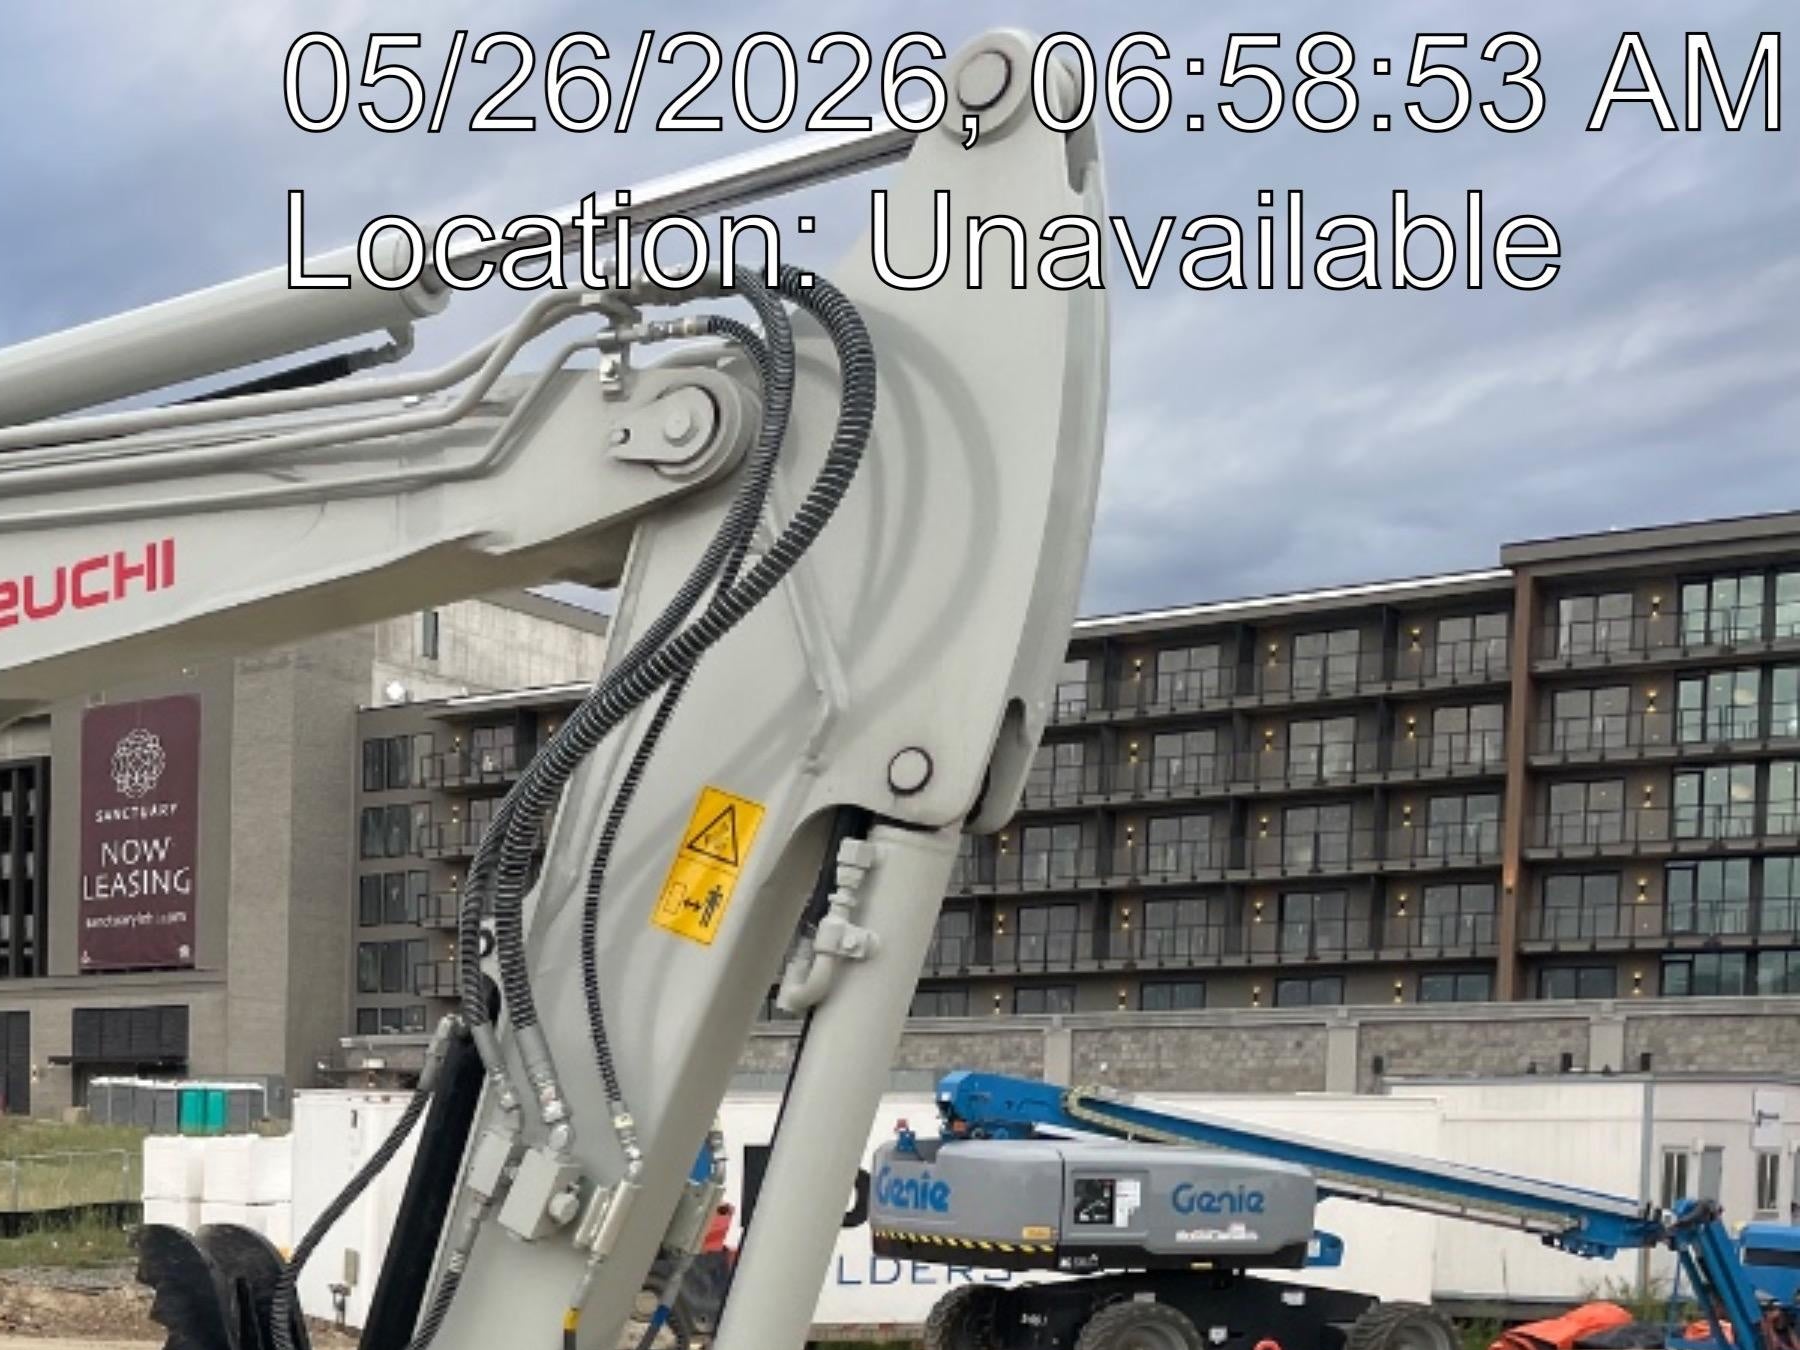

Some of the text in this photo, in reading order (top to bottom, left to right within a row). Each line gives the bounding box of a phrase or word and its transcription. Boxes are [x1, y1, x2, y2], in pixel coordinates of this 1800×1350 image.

[95, 803, 178, 822] SANCTUARY
[101, 837, 171, 867] NOW
[83, 867, 191, 900] LEASING
[875, 1166, 949, 1212] Genie
[1172, 1182, 1264, 1214] Genie
